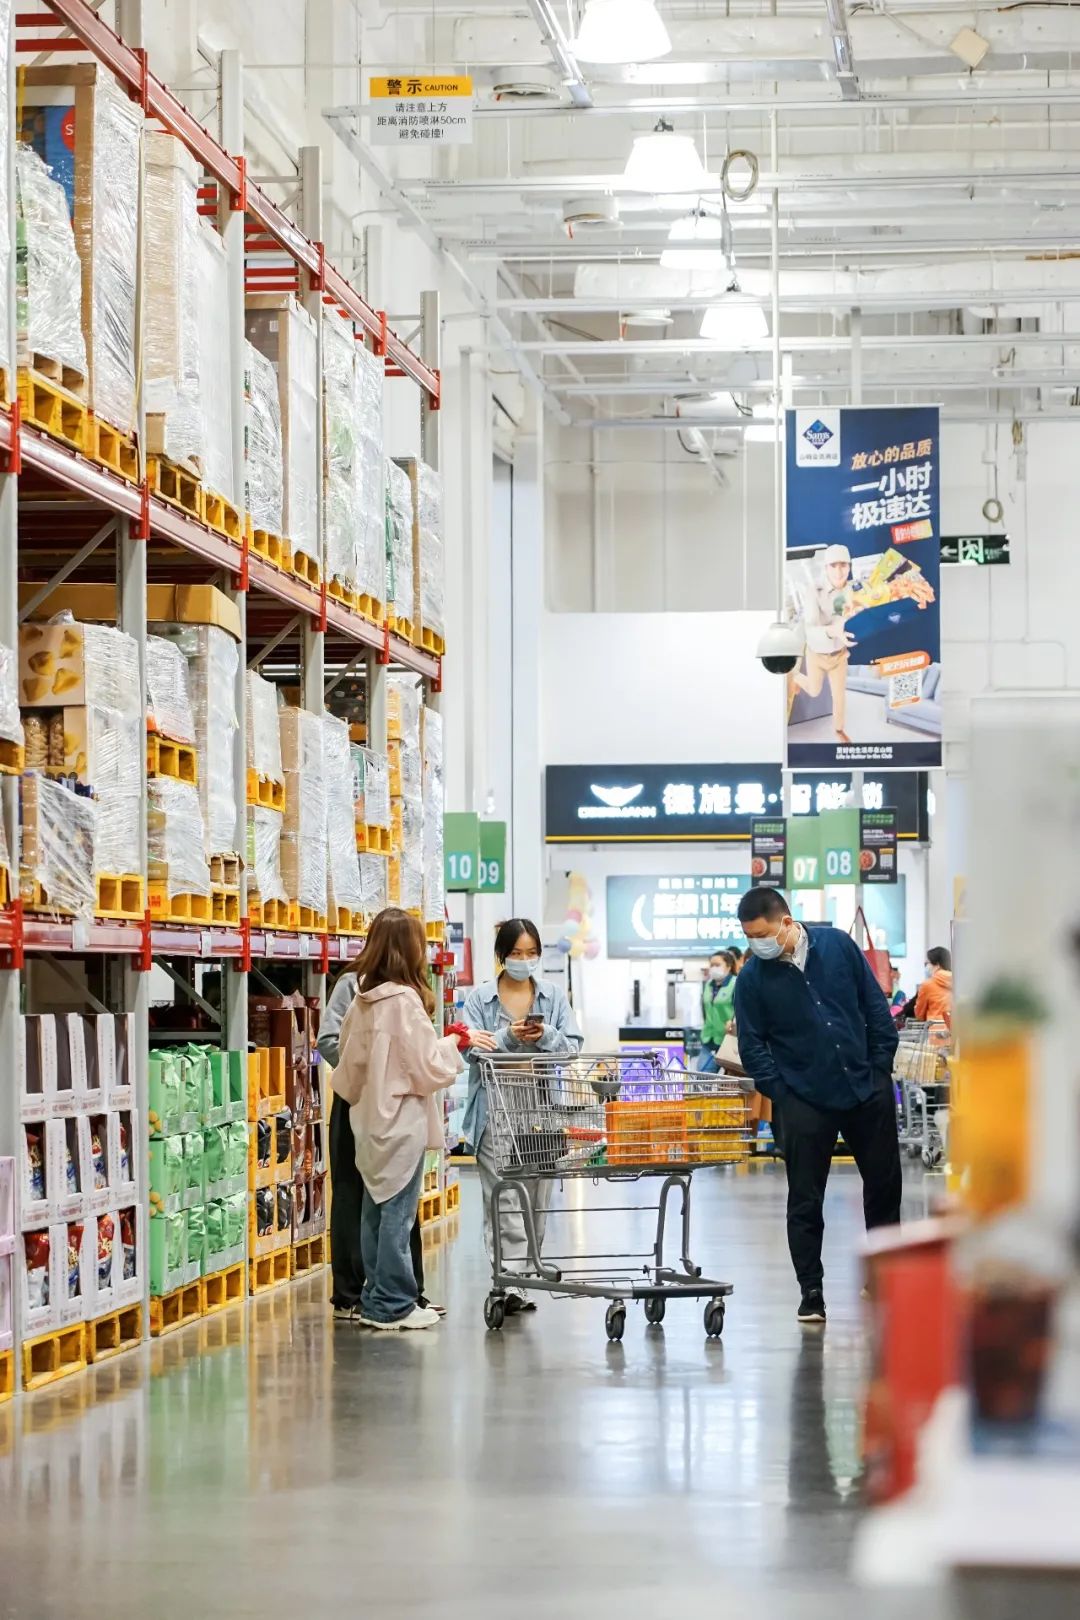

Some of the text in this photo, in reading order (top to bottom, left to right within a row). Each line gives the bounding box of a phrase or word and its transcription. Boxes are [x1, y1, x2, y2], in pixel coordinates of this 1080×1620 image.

[424, 84, 458, 92] CAUTION
[395, 102, 448, 112] 请注意上方
[377, 115, 467, 126] 距离消防喷淋50cm
[851, 438, 932, 470] 放心的品质
[851, 461, 932, 496] 一小时
[851, 491, 932, 531] 极速达
[448, 855, 472, 879] 10
[793, 857, 818, 883] 07
[826, 850, 852, 876] 08
